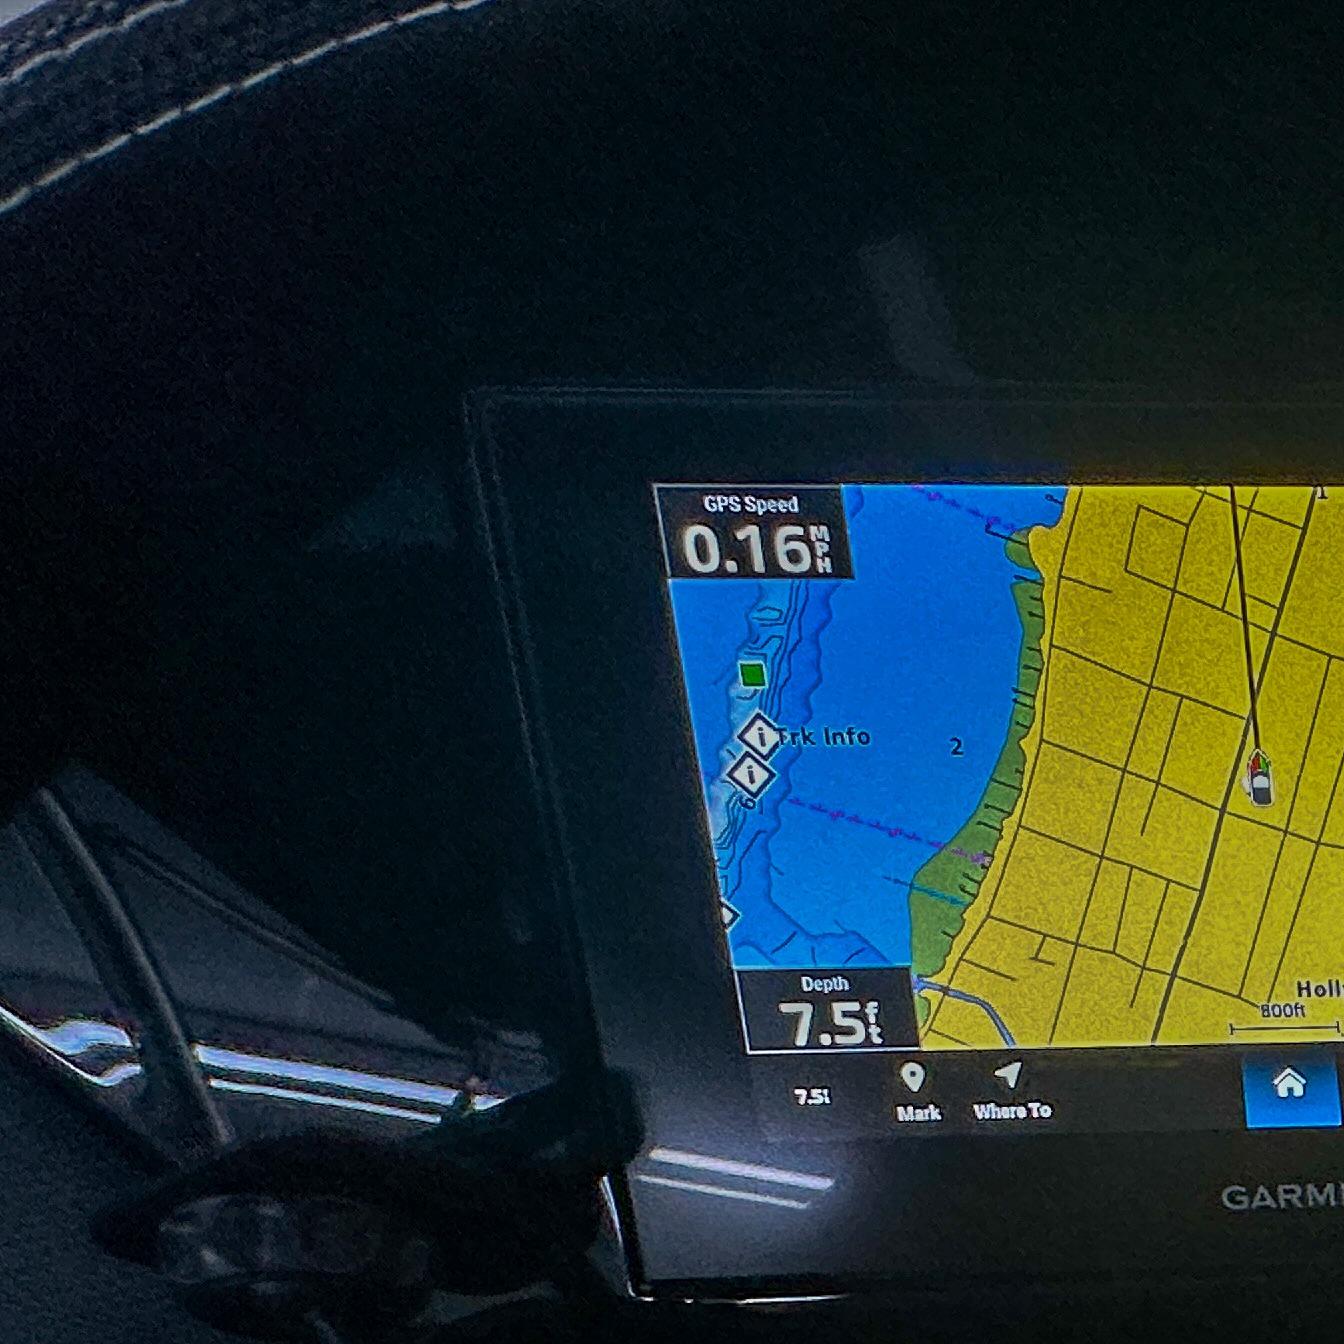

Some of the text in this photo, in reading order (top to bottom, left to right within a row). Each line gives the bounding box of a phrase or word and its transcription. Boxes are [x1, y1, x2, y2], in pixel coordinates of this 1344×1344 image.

[704, 495, 800, 516] GPS Speed
[683, 525, 810, 574] 0.16
[823, 726, 871, 746] Info
[950, 737, 964, 756] 2
[801, 975, 850, 993] Depth
[896, 1103, 943, 1122] Mark
[973, 1102, 1052, 1120] Where To
